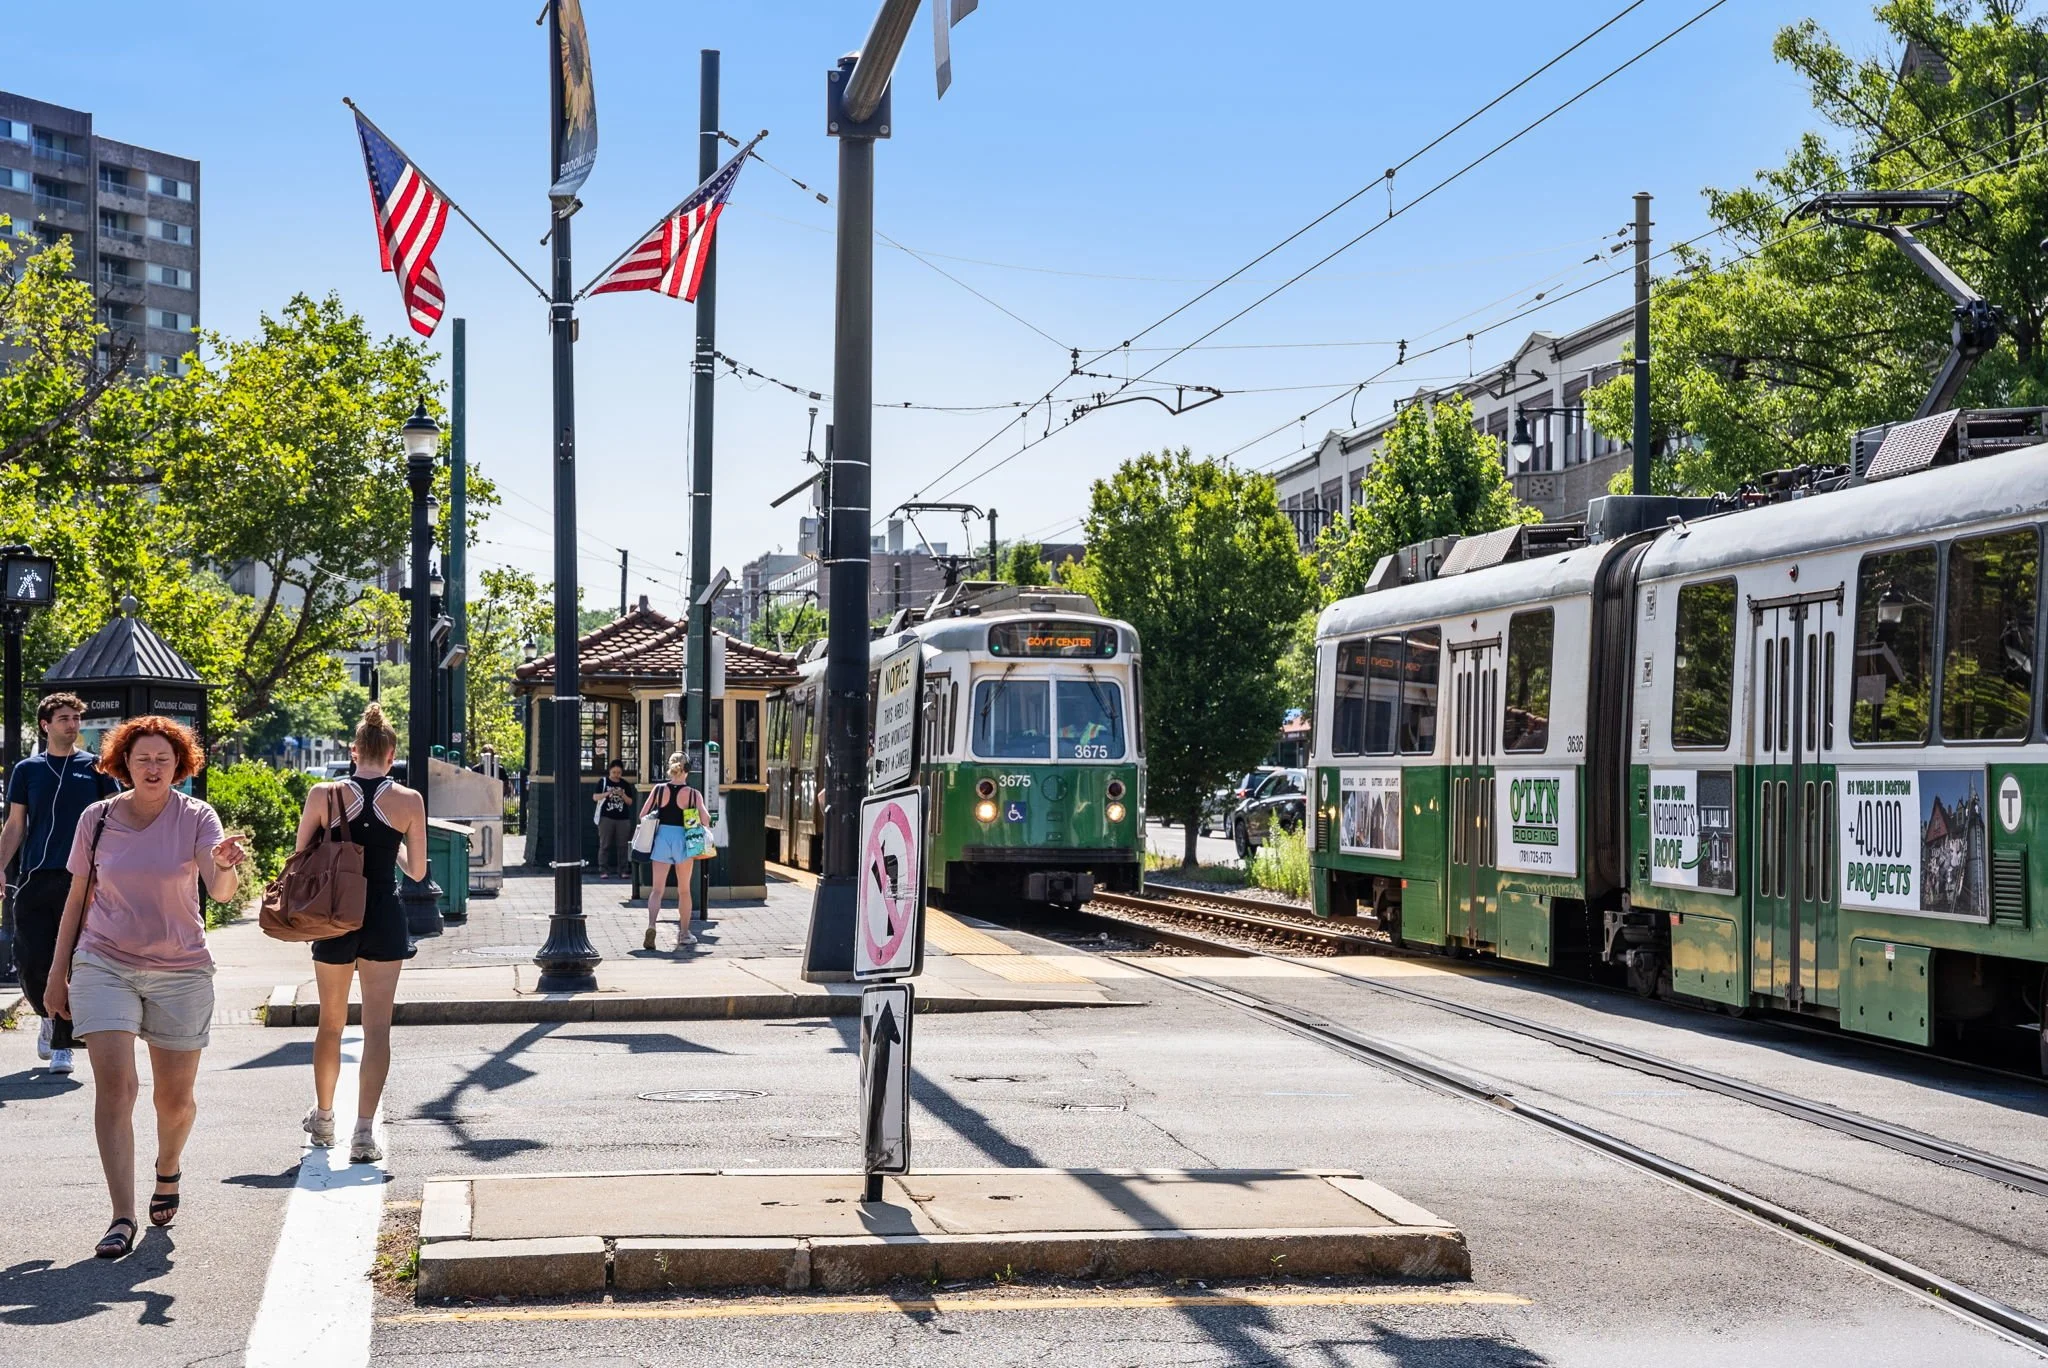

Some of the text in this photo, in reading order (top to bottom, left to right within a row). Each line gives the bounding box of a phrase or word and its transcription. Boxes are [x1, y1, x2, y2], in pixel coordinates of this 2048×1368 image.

[1027, 636, 1092, 647] GOV'T CENTER
[884, 658, 910, 696] NOTICE
[91, 700, 120, 710] CORNER
[178, 702, 198, 712] CORNER
[1074, 744, 1108, 759] 3675
[1566, 735, 1584, 753] 3636
[999, 774, 1031, 787] 3675
[1856, 780, 1874, 796] YEARS
[1876, 780, 1883, 796] IN
[1885, 780, 1911, 796] BOSTON
[1509, 777, 1560, 825] O'LYN
[2002, 789, 2018, 824] T
[1653, 802, 1695, 837] NEIGHBOR'S
[1514, 829, 1557, 842] ROOFING
[1654, 838, 1682, 869] ROOF
[1847, 861, 1912, 901] PROJECTS
